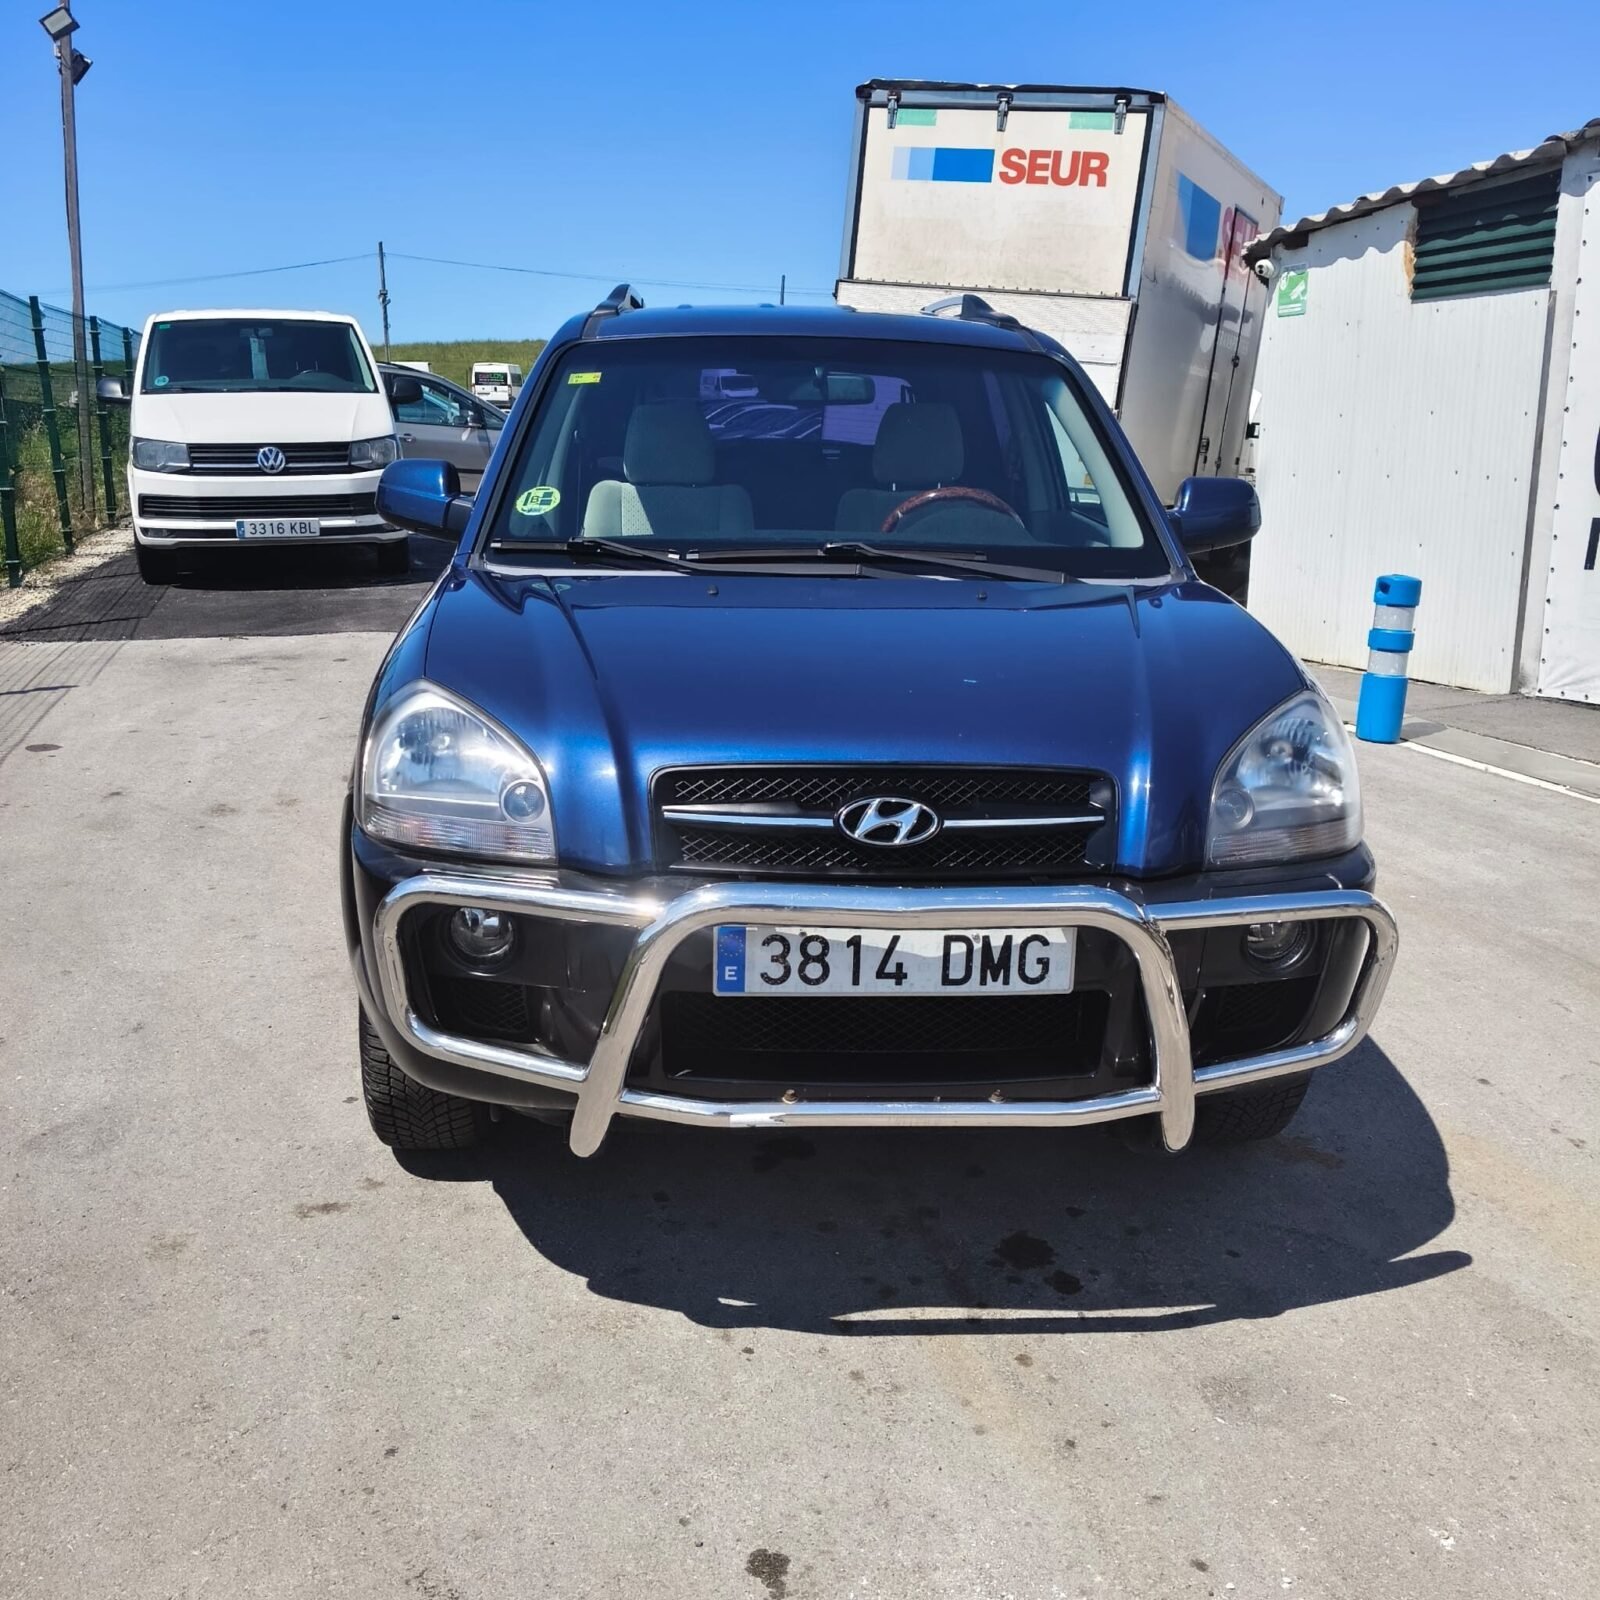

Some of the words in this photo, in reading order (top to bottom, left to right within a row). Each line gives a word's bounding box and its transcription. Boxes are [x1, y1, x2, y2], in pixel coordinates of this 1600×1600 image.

[999, 147, 1110, 188] SEUR
[249, 522, 285, 535] 3316
[290, 521, 317, 535] KBL
[724, 965, 738, 981] E
[759, 933, 908, 987] 3814
[940, 933, 1051, 987] DMG
